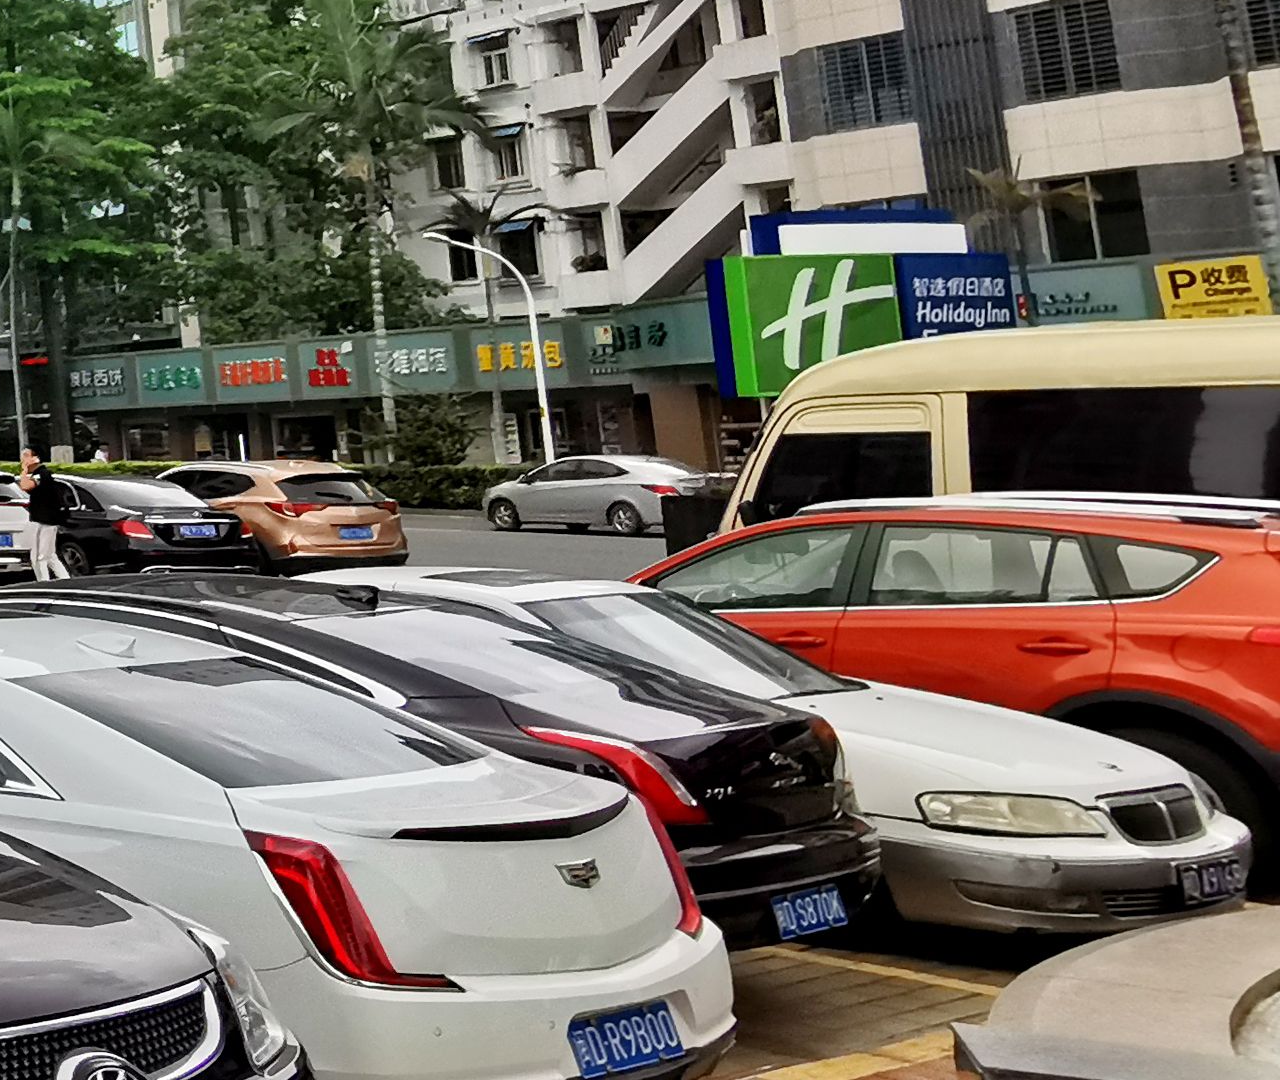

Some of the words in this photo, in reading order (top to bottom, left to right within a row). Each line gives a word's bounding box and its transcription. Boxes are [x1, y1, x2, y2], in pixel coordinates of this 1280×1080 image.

[1168, 269, 1197, 299] P
[1200, 265, 1250, 286] 收费
[916, 301, 985, 327] Holiday
[987, 301, 1010, 323] Inn
